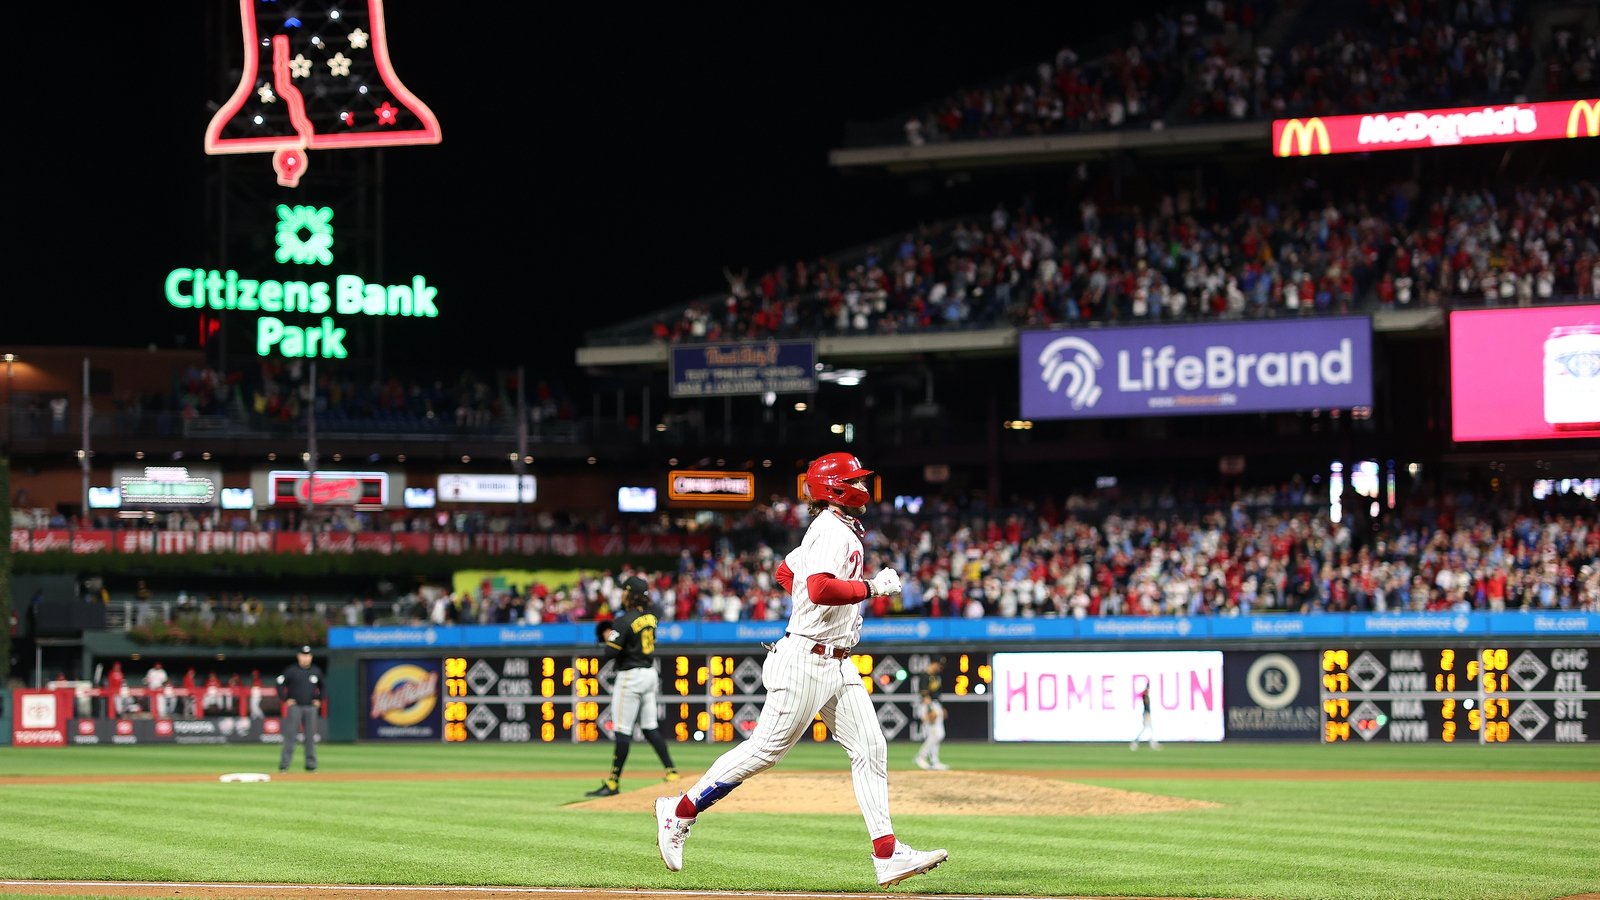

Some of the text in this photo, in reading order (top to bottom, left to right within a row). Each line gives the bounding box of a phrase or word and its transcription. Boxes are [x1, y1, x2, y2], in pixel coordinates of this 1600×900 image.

[1358, 106, 1536, 144] McDonald's
[165, 268, 438, 317] Citizens Bank
[257, 316, 348, 359] Park
[1117, 337, 1353, 392] LifeBrand
[1094, 620, 1174, 635] Independence
[1252, 619, 1303, 632] ibx.com
[1365, 616, 1452, 632] Independence
[1534, 616, 1587, 630] ibx.com
[503, 658, 529, 676] ARI
[542, 658, 554, 677] 3
[576, 658, 598, 675] 41
[676, 656, 688, 676] 3
[960, 654, 969, 673] 1
[978, 665, 992, 684] 4
[1390, 650, 1424, 671] MIA
[1441, 649, 1455, 671] 2
[1482, 649, 1589, 670] 50 CHC
[576, 678, 688, 697] 57 4
[955, 675, 969, 696] 2
[1007, 668, 1213, 712] HOME RUN
[1323, 672, 1455, 692] 47 NYM 11
[1483, 672, 1588, 693] 51 ATL
[505, 702, 526, 721] TB
[542, 702, 554, 721] 5
[680, 702, 688, 720] 1
[1323, 698, 1349, 718] 47
[1391, 698, 1425, 719] MIA
[1442, 698, 1455, 719] 2
[1484, 698, 1588, 719] 57 STL
[15, 730, 63, 744] TOYOTA
[174, 720, 215, 733] TOYOTA
[500, 722, 531, 742] BOS
[675, 722, 688, 742] 5
[1389, 721, 1429, 742] NYM
[1442, 721, 1456, 742] 2
[1555, 721, 1588, 742] MIL
